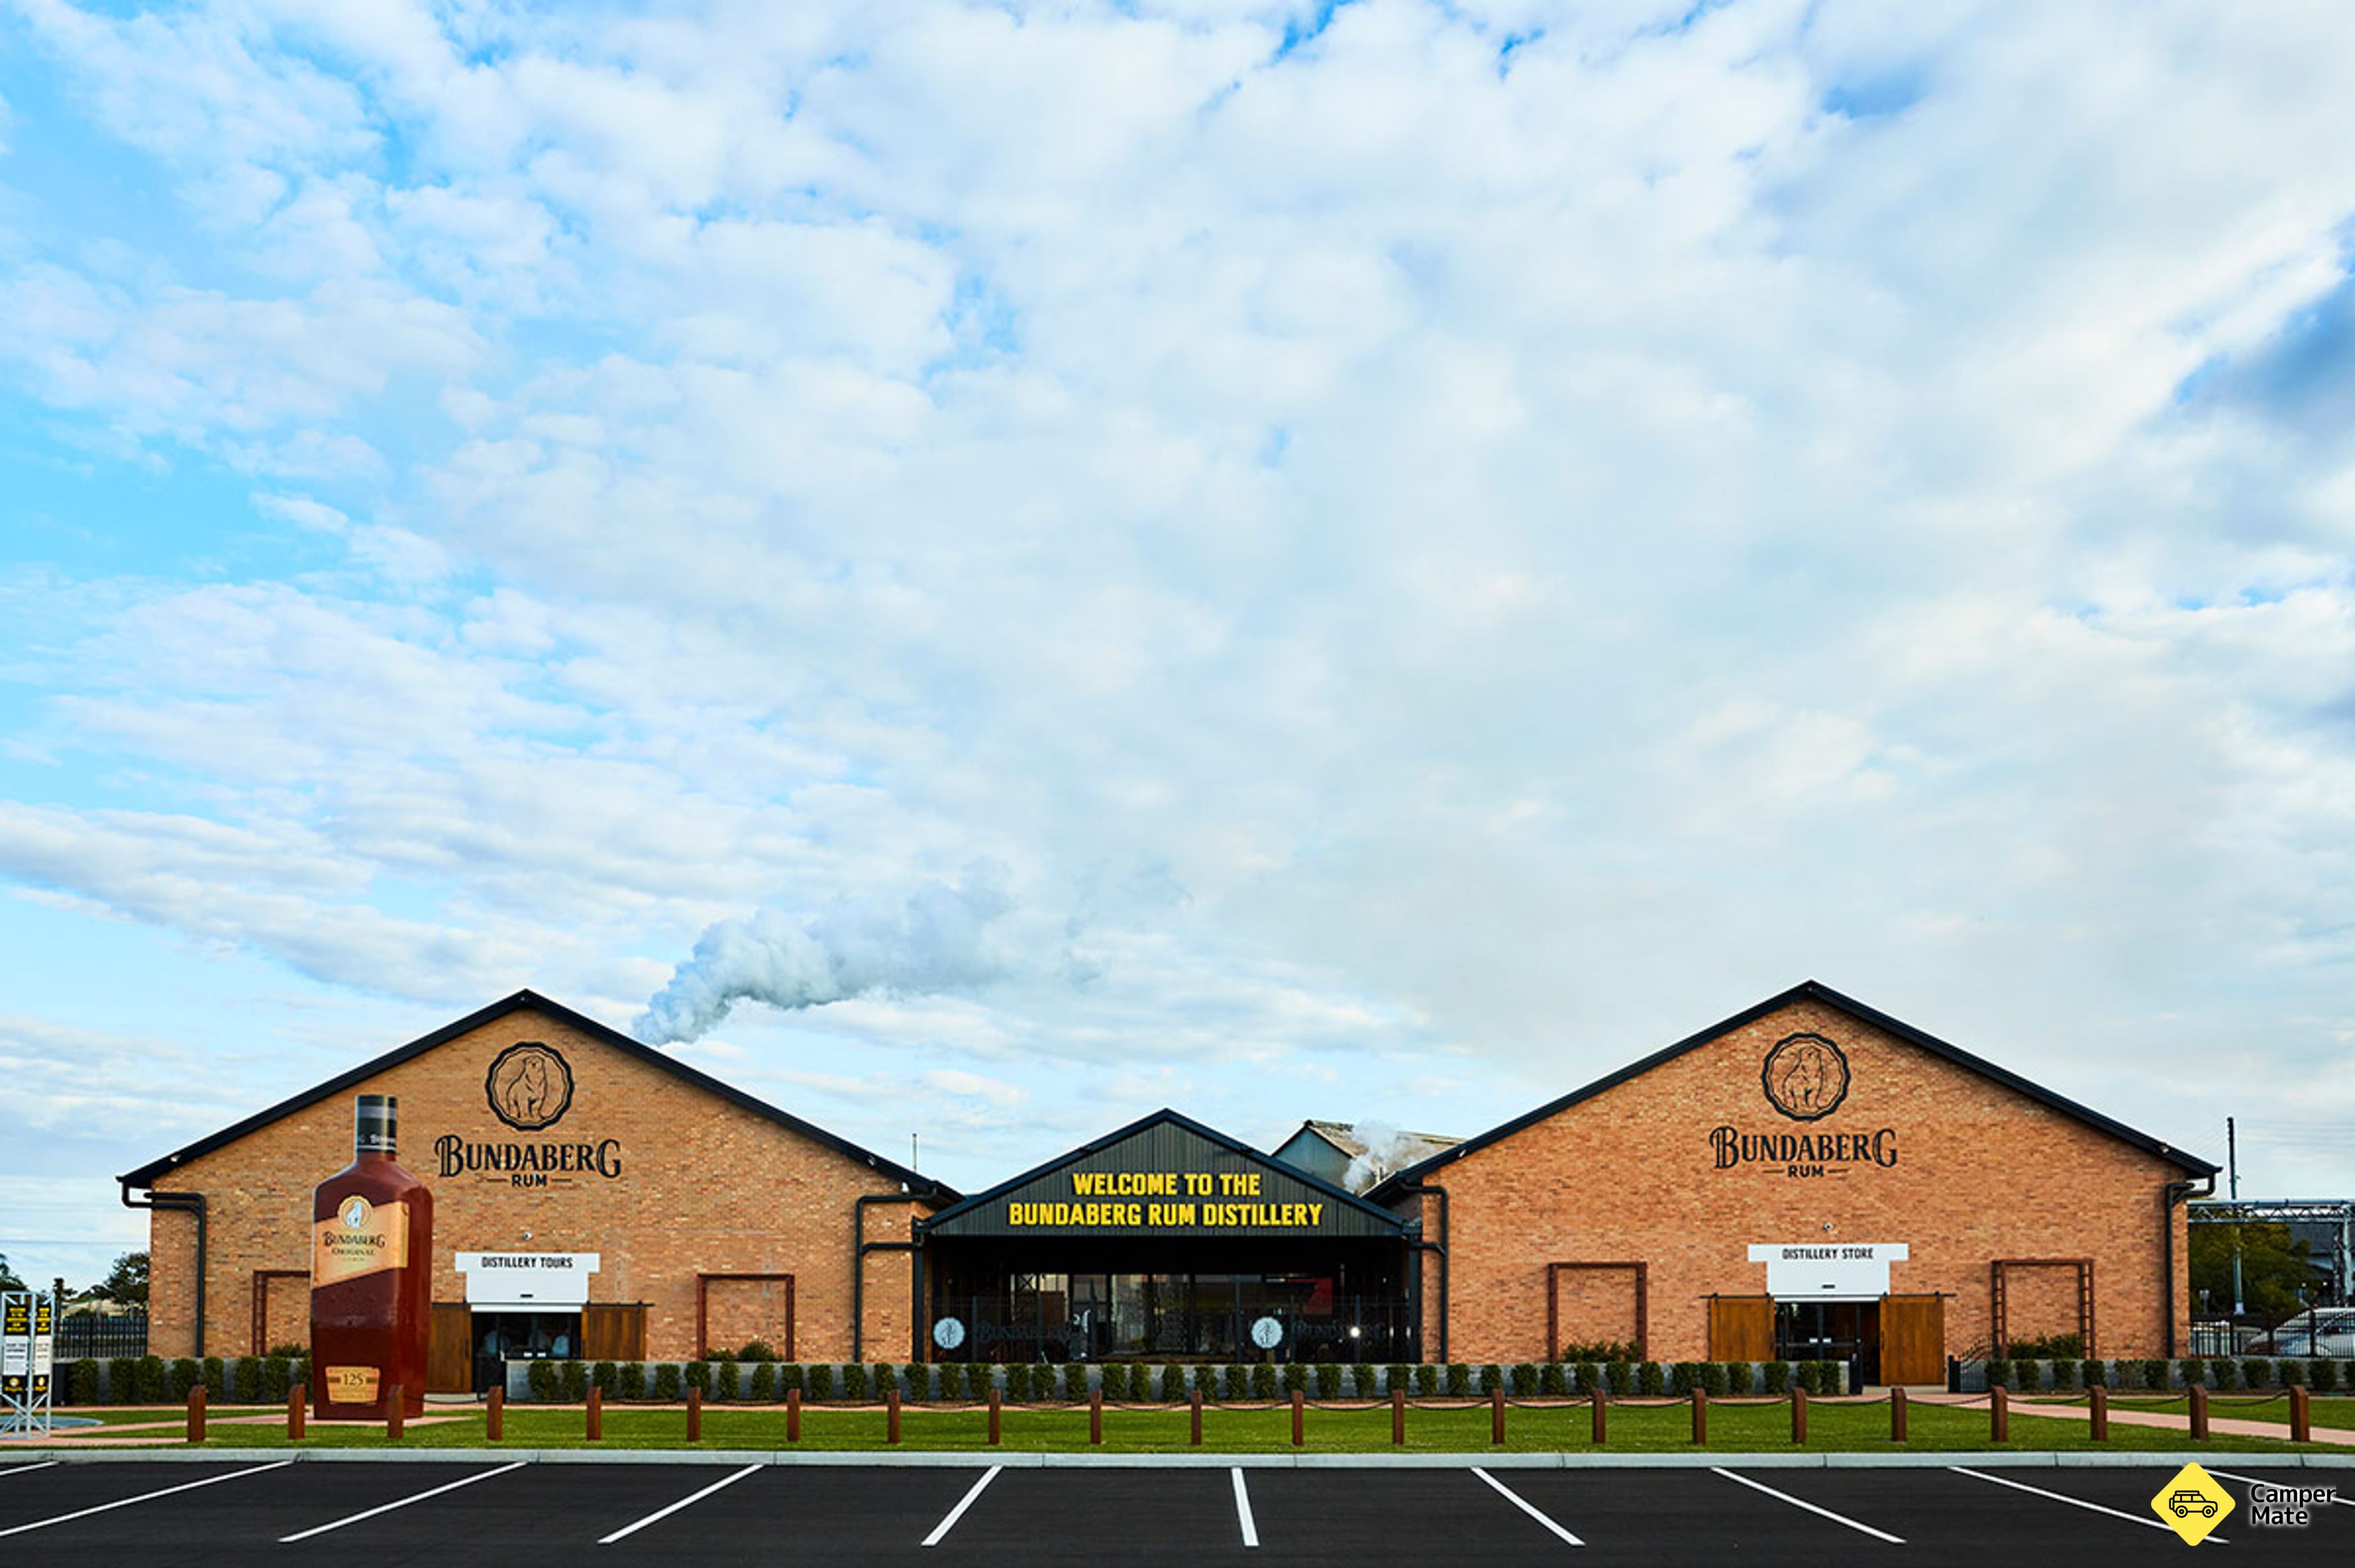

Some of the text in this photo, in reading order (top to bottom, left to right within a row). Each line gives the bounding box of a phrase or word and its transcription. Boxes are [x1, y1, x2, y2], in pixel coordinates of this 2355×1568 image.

[1709, 1125, 1898, 1168] BUNDABERG
[434, 1134, 621, 1178] BUNDABERG
[1787, 1165, 1825, 1178] RUM
[512, 1174, 548, 1187] RUM
[1072, 1172, 1261, 1196] WELCOME TO THE
[1009, 1202, 1324, 1226] BUNDABERG RUM DISTILLERY
[1782, 1247, 1874, 1260] DISTILLERY STORE
[481, 1256, 574, 1268] DISTILLERY TOURS
[344, 1372, 364, 1386] 125
